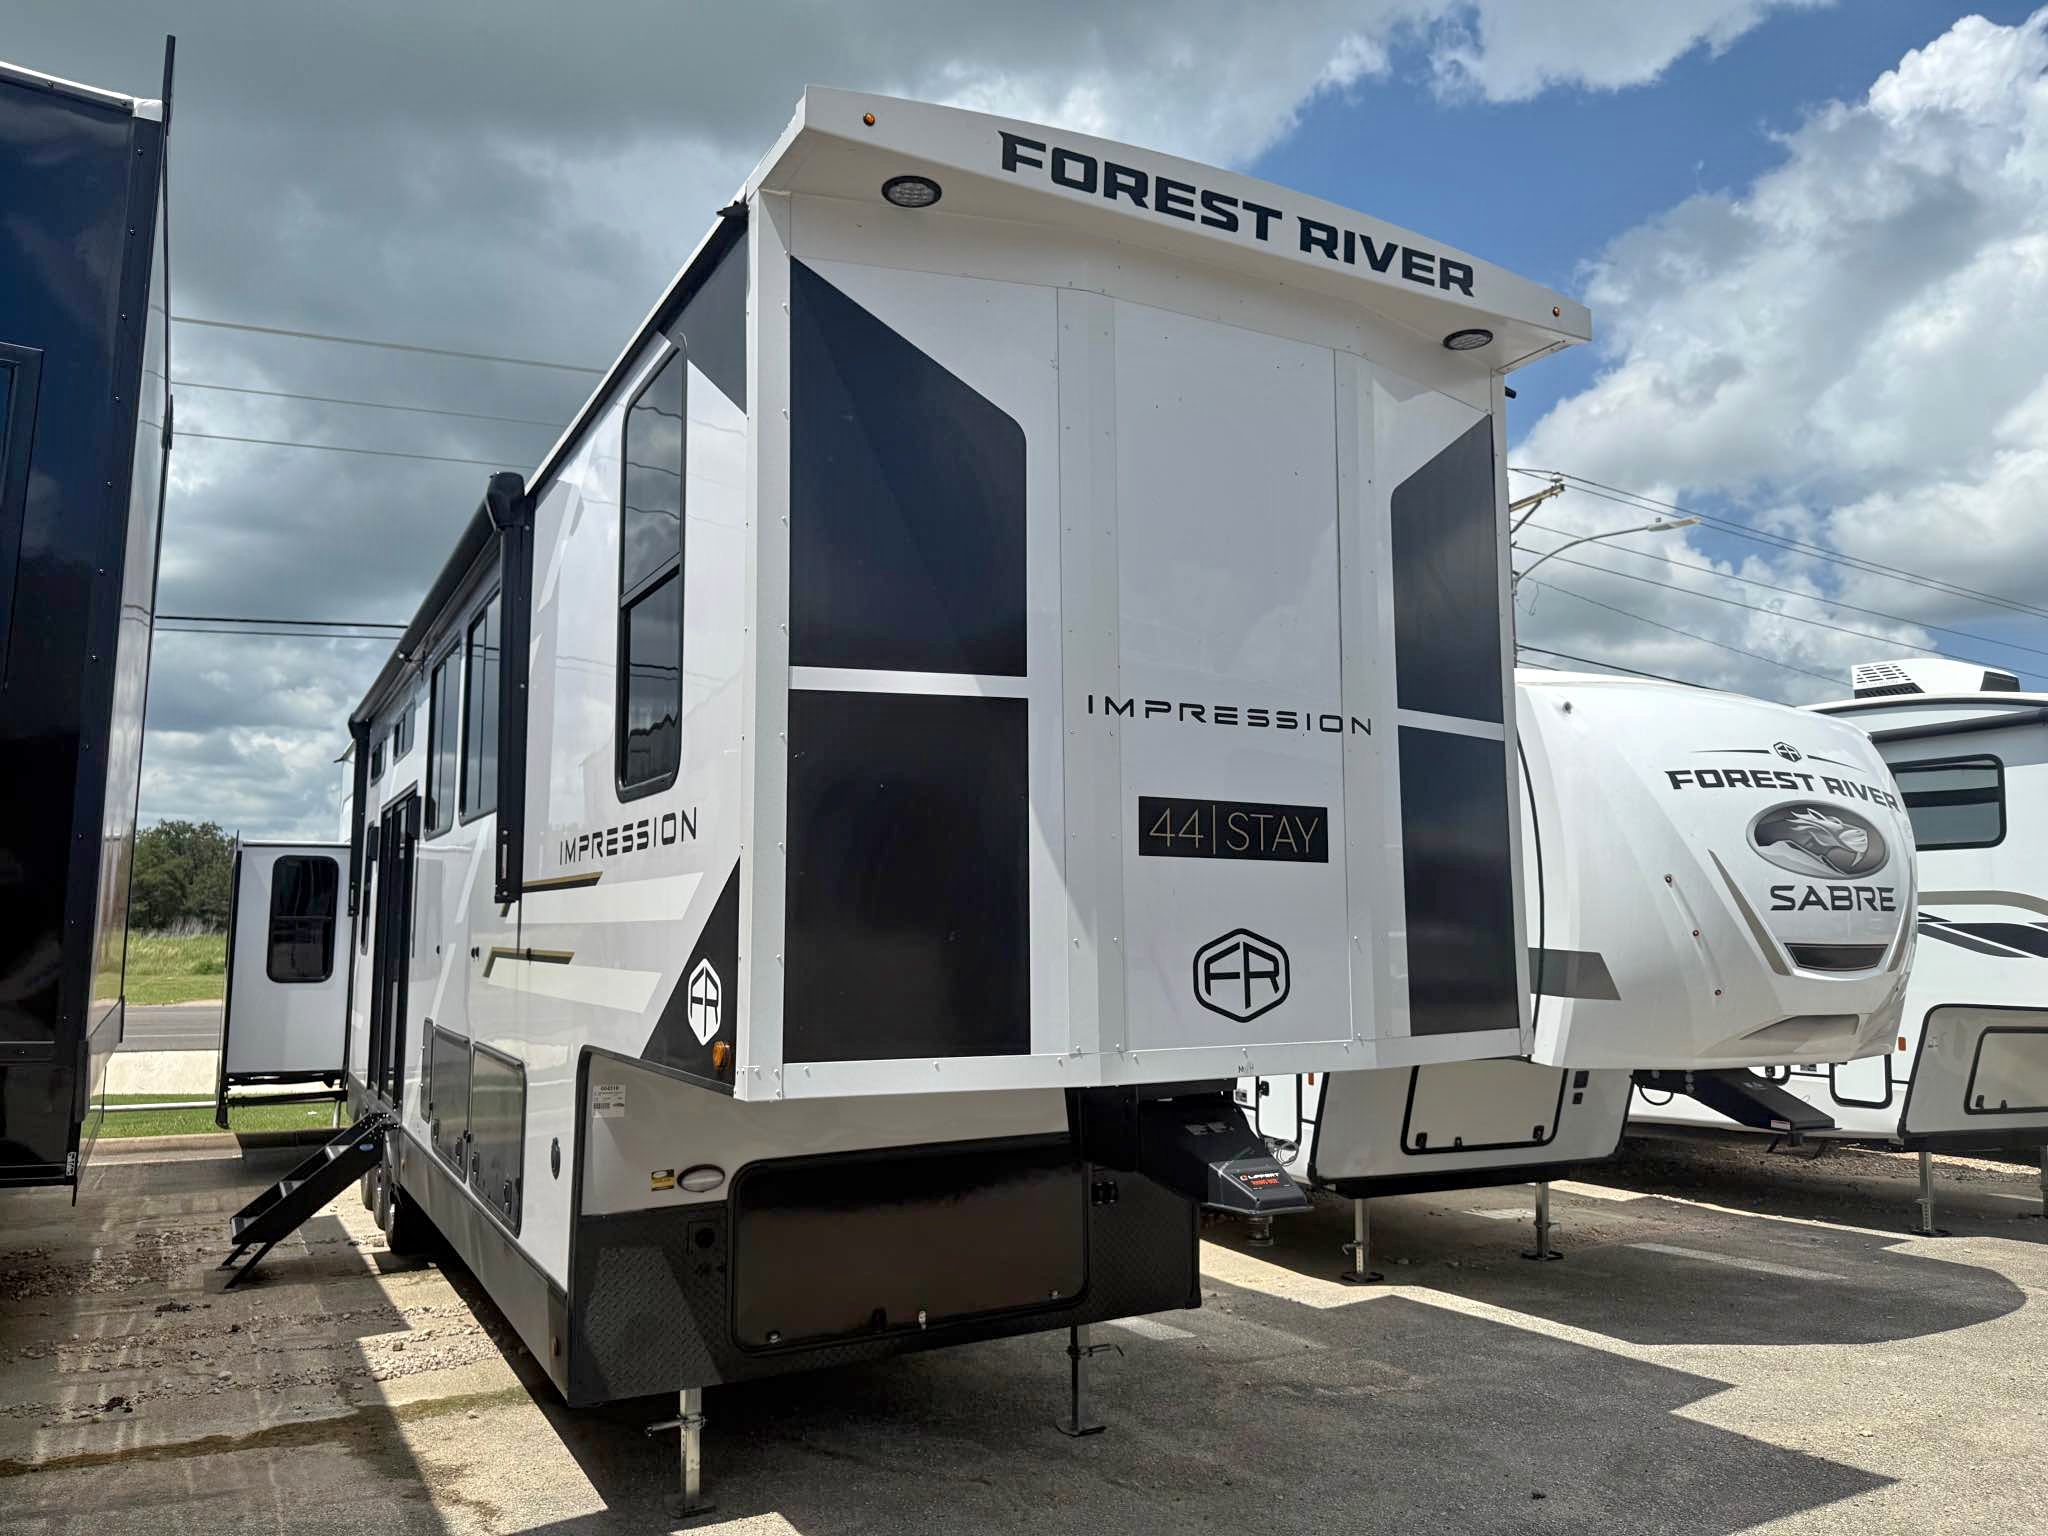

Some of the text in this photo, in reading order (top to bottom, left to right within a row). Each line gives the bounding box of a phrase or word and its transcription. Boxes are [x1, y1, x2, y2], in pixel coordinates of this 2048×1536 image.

[998, 130, 1475, 298] FOREST RIVER
[1088, 694, 1372, 736] IMPRESSION
[1664, 769, 1901, 814] FOREST RIVER
[559, 806, 697, 866] IMPRESSION
[1769, 885, 1897, 912] SABRE
